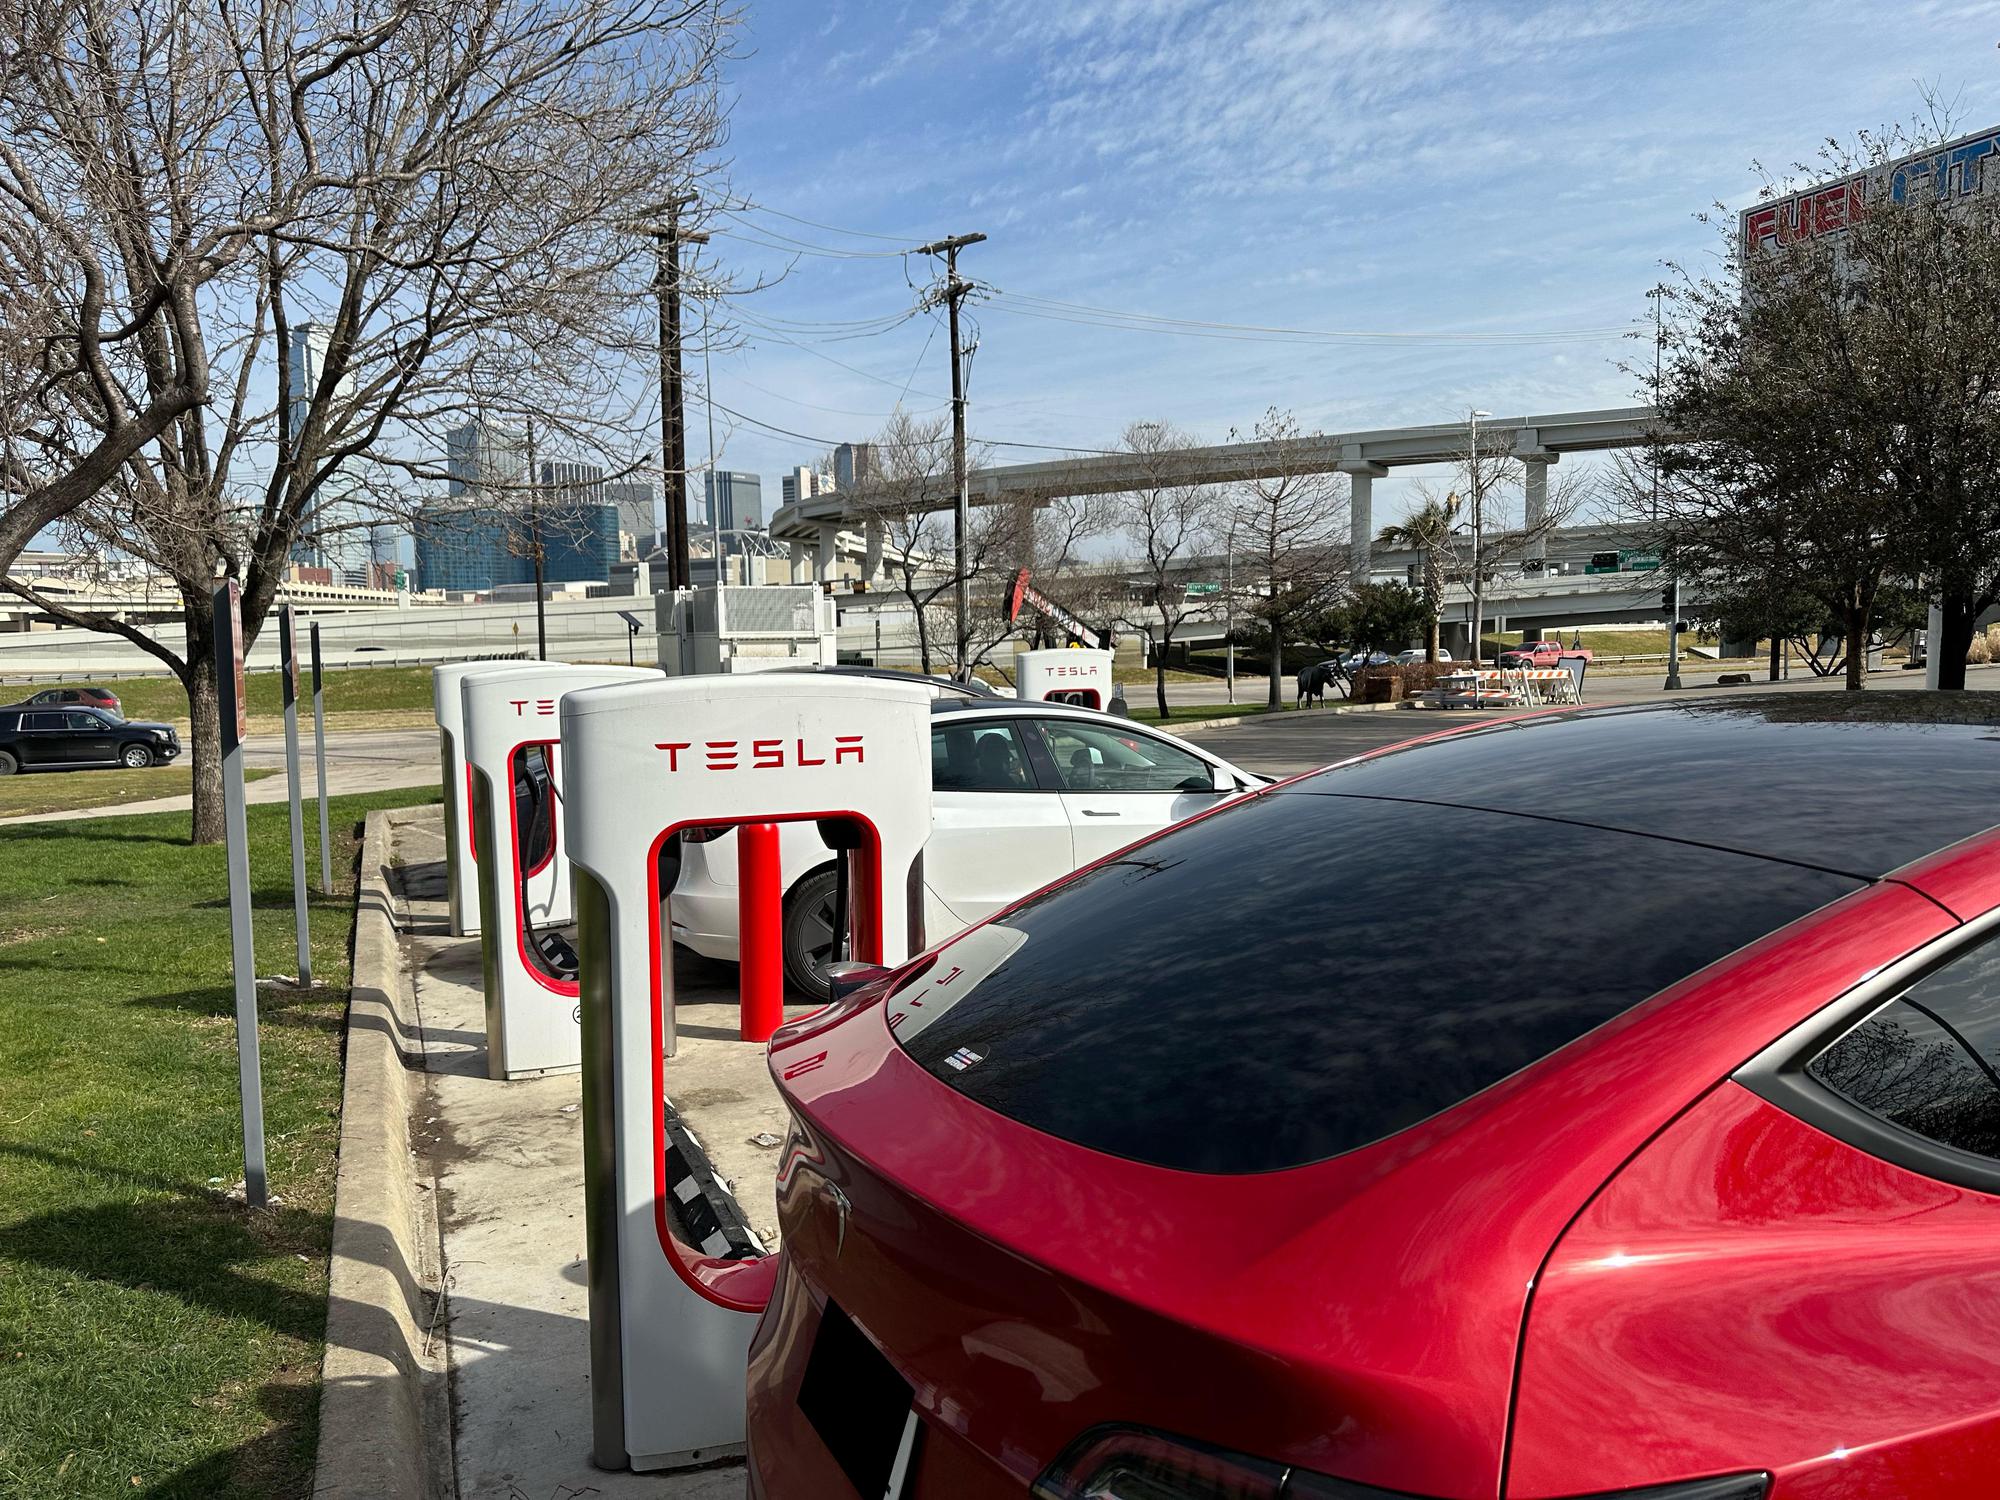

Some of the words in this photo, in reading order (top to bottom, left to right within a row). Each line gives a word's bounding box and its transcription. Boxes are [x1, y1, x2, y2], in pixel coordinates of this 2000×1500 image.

[1890, 134, 2000, 206] CIT
[1045, 666, 1097, 676] TESLA
[655, 736, 864, 771] TESLA
